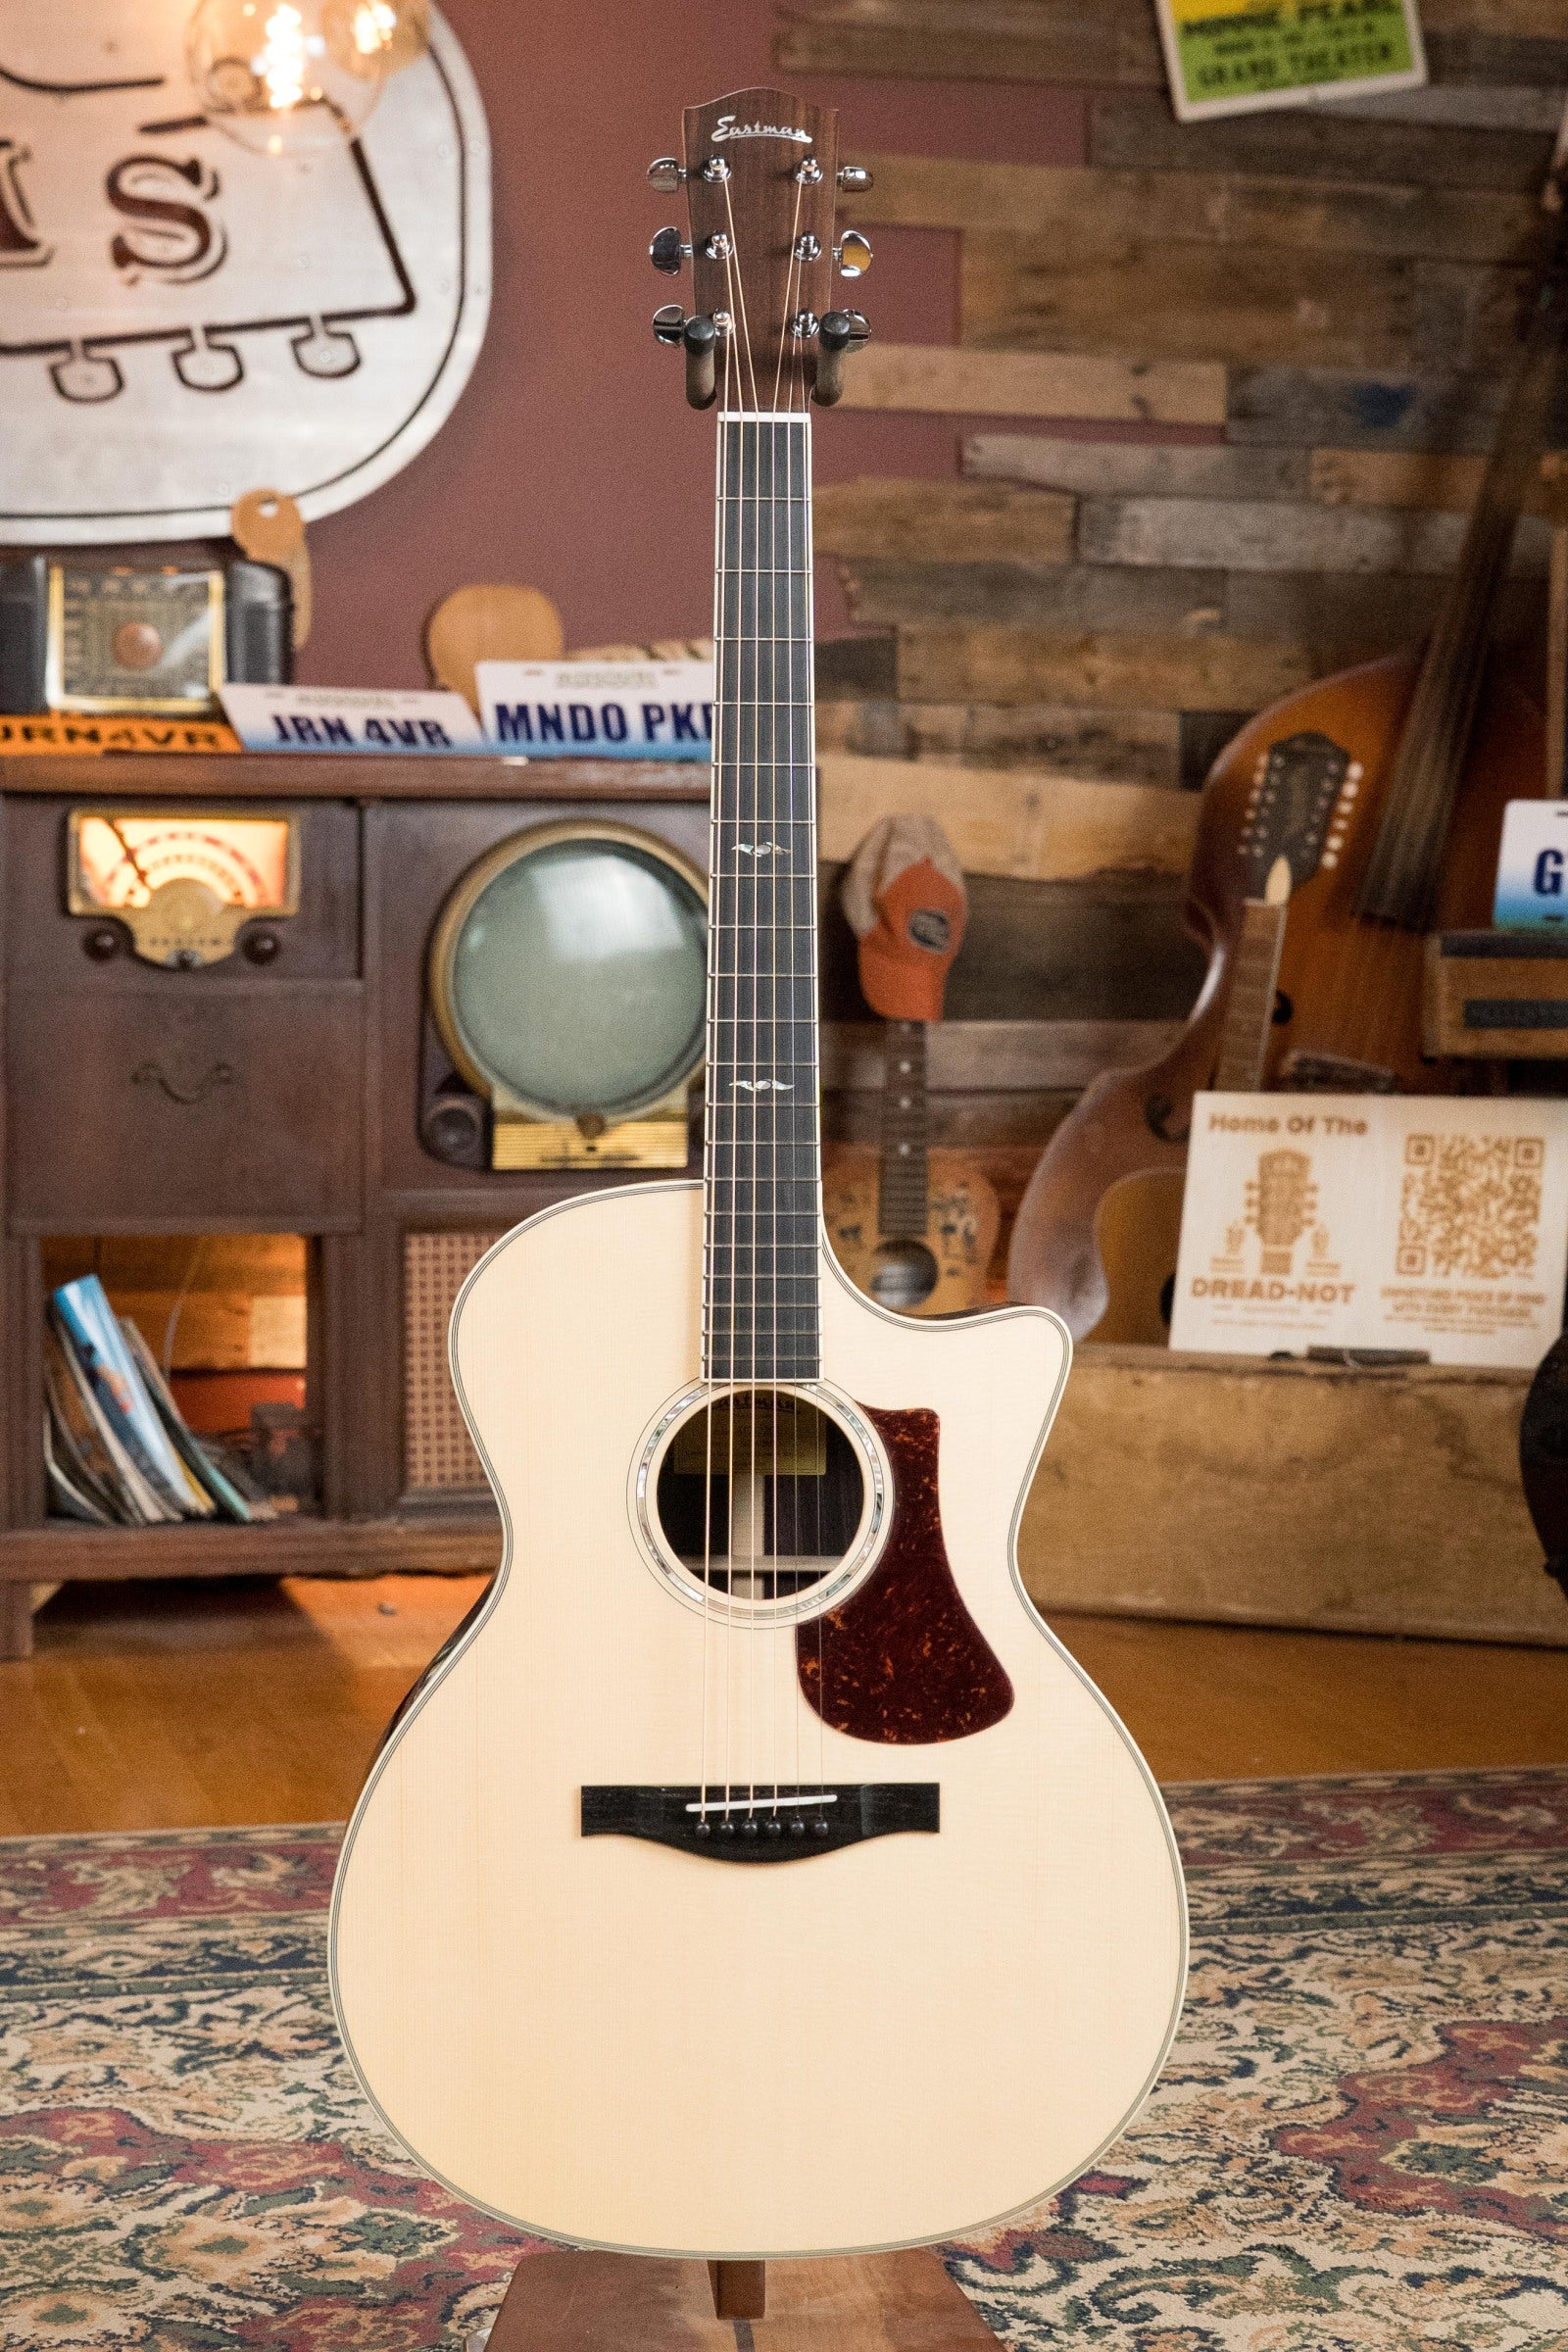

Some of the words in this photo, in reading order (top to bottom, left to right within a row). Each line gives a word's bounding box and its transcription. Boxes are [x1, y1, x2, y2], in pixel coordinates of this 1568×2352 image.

[710, 115, 813, 144] Eastman
[495, 702, 628, 742] MNDO
[1208, 1112, 1280, 1135] Home
[1287, 1113, 1317, 1136] Of
[1322, 1115, 1368, 1138] The
[1190, 1276, 1356, 1305] DREAD-NOT
